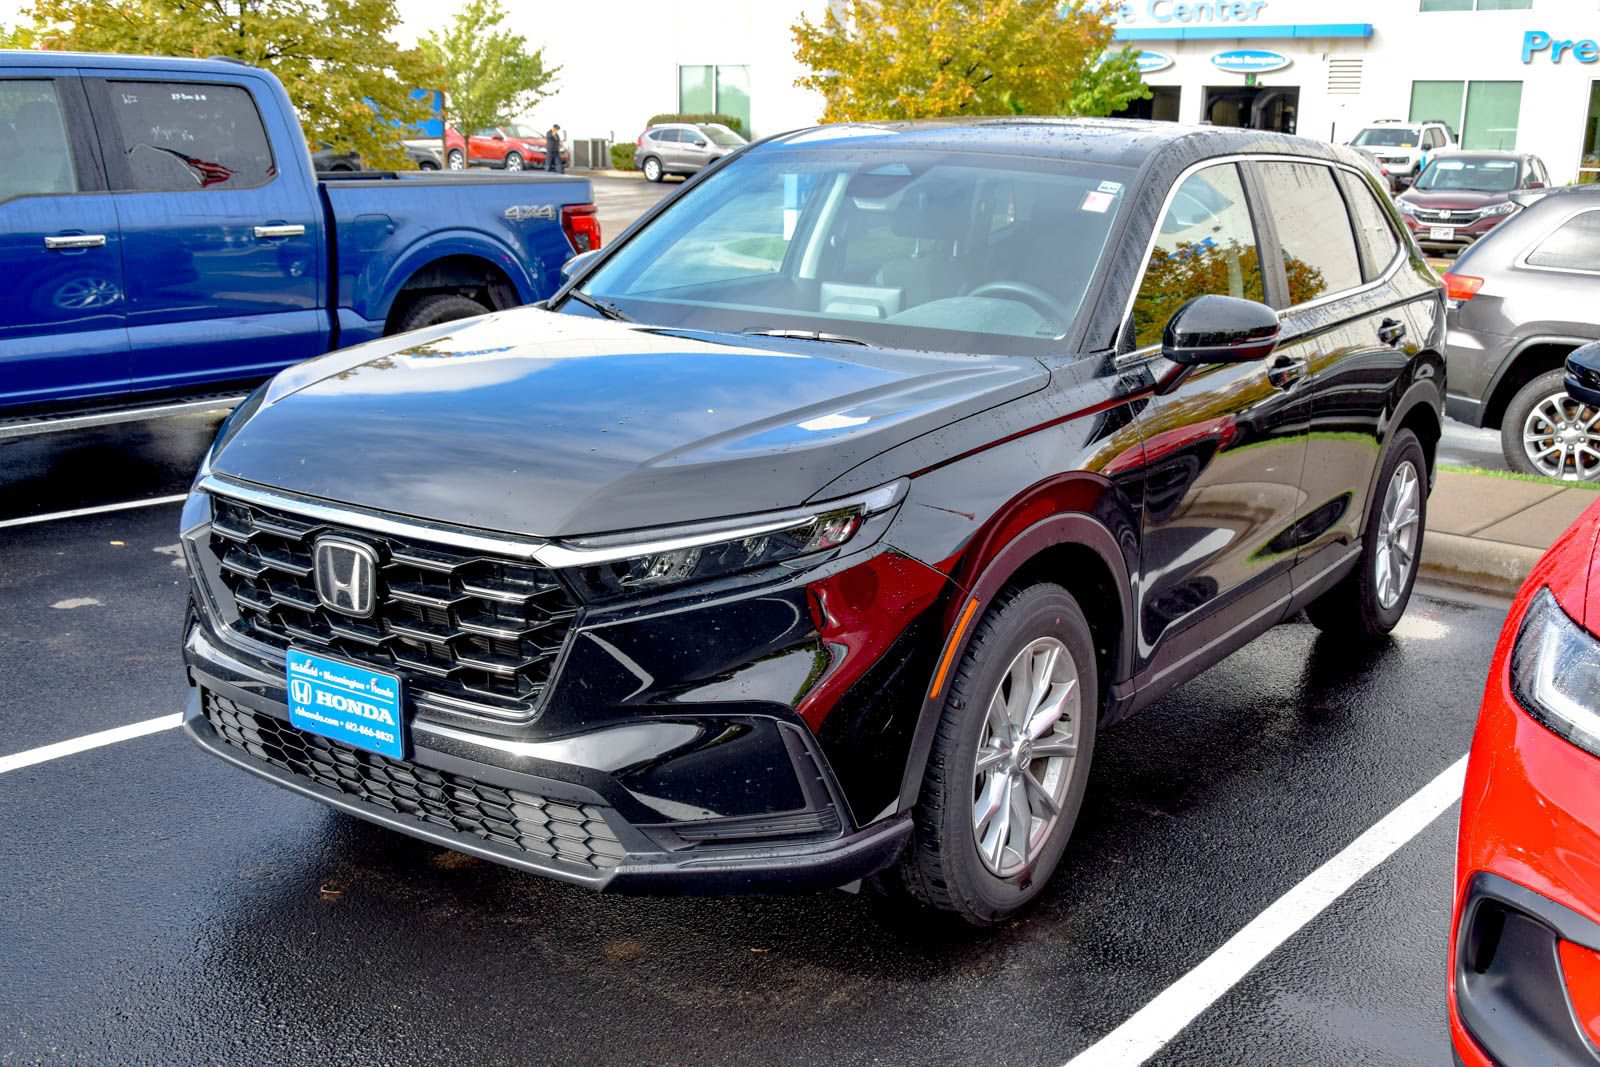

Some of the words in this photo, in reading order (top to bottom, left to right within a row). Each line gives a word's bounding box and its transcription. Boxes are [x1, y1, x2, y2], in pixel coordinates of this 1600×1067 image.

[1147, 0, 1267, 24] Center
[1521, 30, 1599, 64] Pre
[315, 690, 395, 726] HONDA
